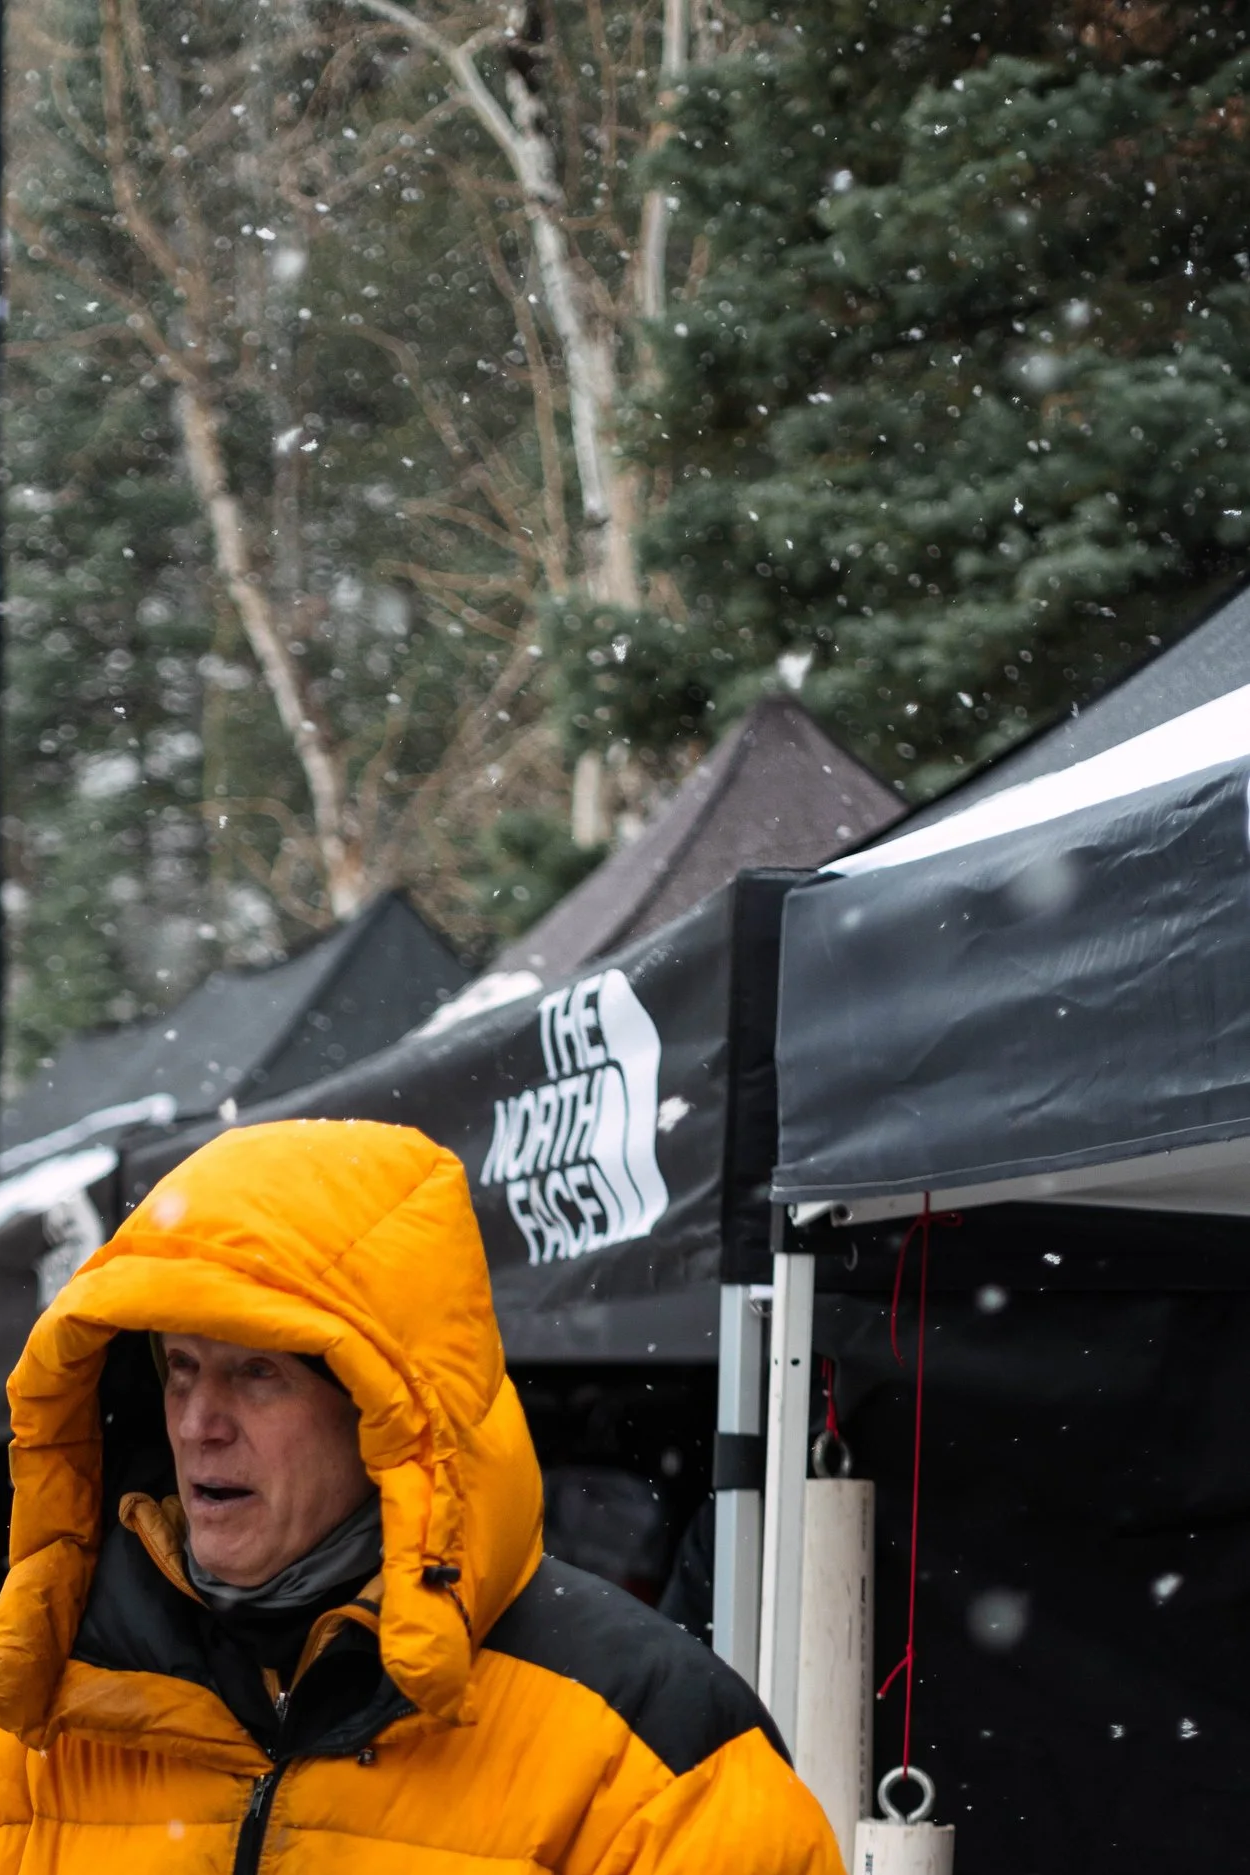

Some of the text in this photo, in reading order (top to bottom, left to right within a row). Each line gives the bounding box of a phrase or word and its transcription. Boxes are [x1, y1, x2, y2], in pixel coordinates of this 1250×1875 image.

[538, 972, 611, 1079] THE
[479, 1066, 603, 1187] NORTH
[505, 1164, 611, 1267] FACE
